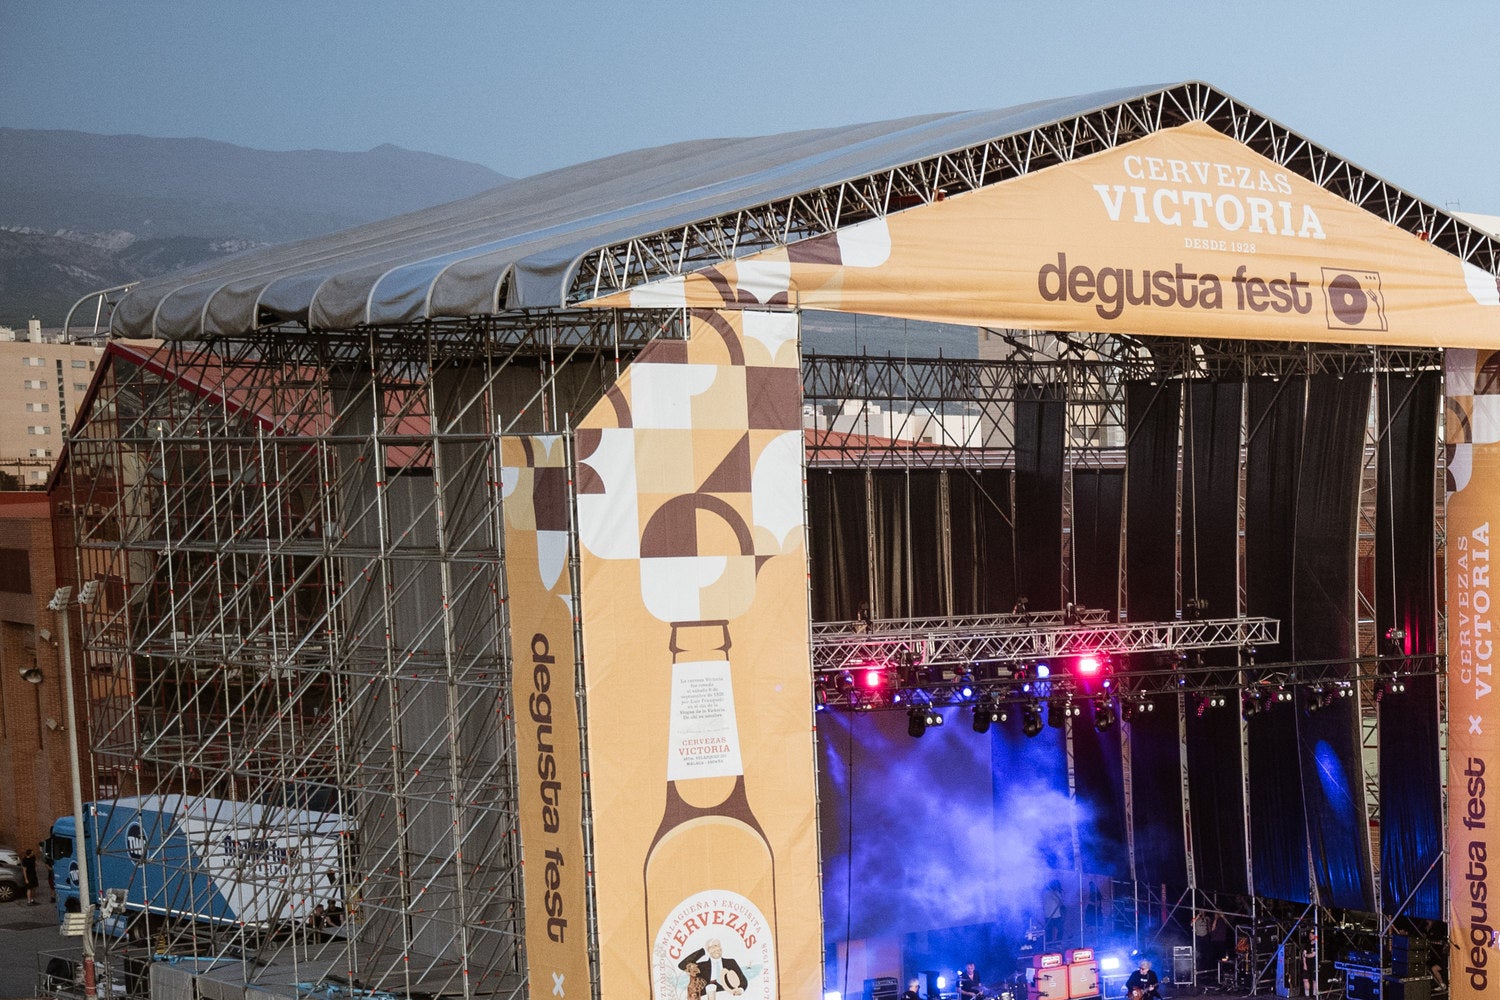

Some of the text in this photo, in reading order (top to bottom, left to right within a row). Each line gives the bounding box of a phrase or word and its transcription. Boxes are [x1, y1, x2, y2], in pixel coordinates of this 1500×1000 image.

[1124, 155, 1292, 195] CERVEZAS
[1093, 184, 1327, 240] VICTORIA
[1185, 238, 1256, 254] DESDE 1928
[1038, 252, 1313, 320] degusta fest
[1460, 536, 1472, 685] CERVEZAS
[1475, 521, 1493, 700] VICTORIA
[529, 632, 562, 834] degusta
[679, 745, 731, 756] VICTORIA
[682, 737, 727, 746] CERVEZAS
[1464, 757, 1487, 831] fest
[544, 847, 568, 943] fest
[662, 900, 711, 946] MALAGUEÑA
[722, 900, 762, 934] EXQUISITA
[1464, 838, 1492, 992] degusta
[669, 910, 758, 960] CERVEZAS
